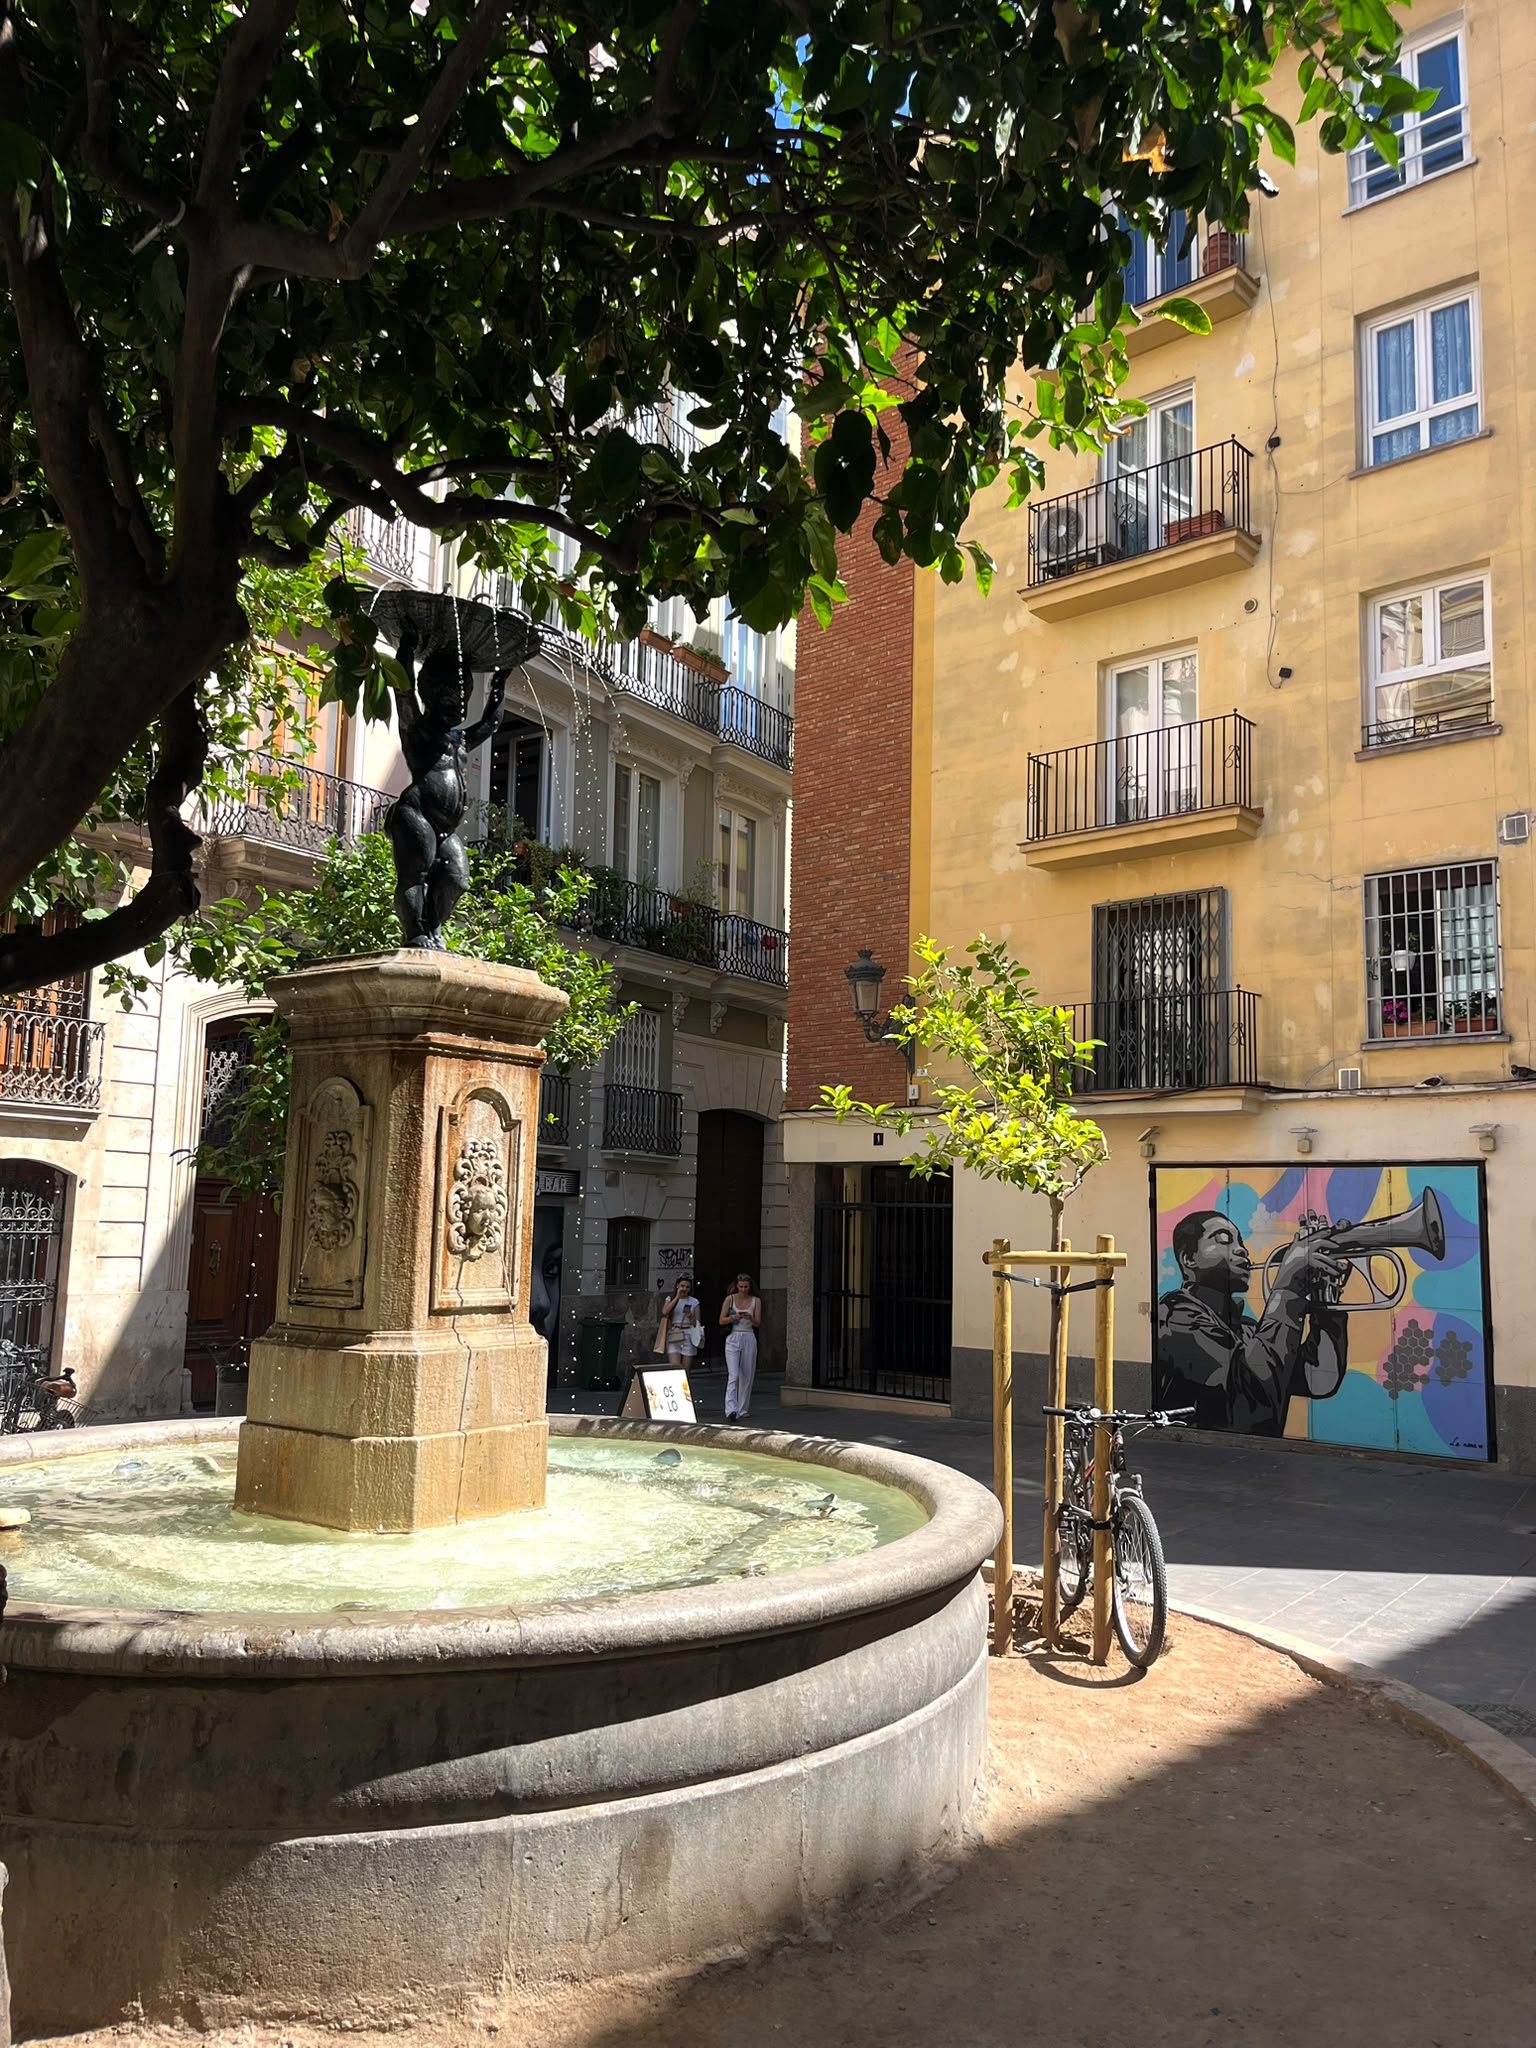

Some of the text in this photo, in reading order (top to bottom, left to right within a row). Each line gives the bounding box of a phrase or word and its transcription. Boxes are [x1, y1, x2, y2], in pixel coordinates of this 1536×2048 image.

[545, 1176, 567, 1192] BAR
[663, 1386, 674, 1398] OS
[667, 1400, 678, 1412] LO
